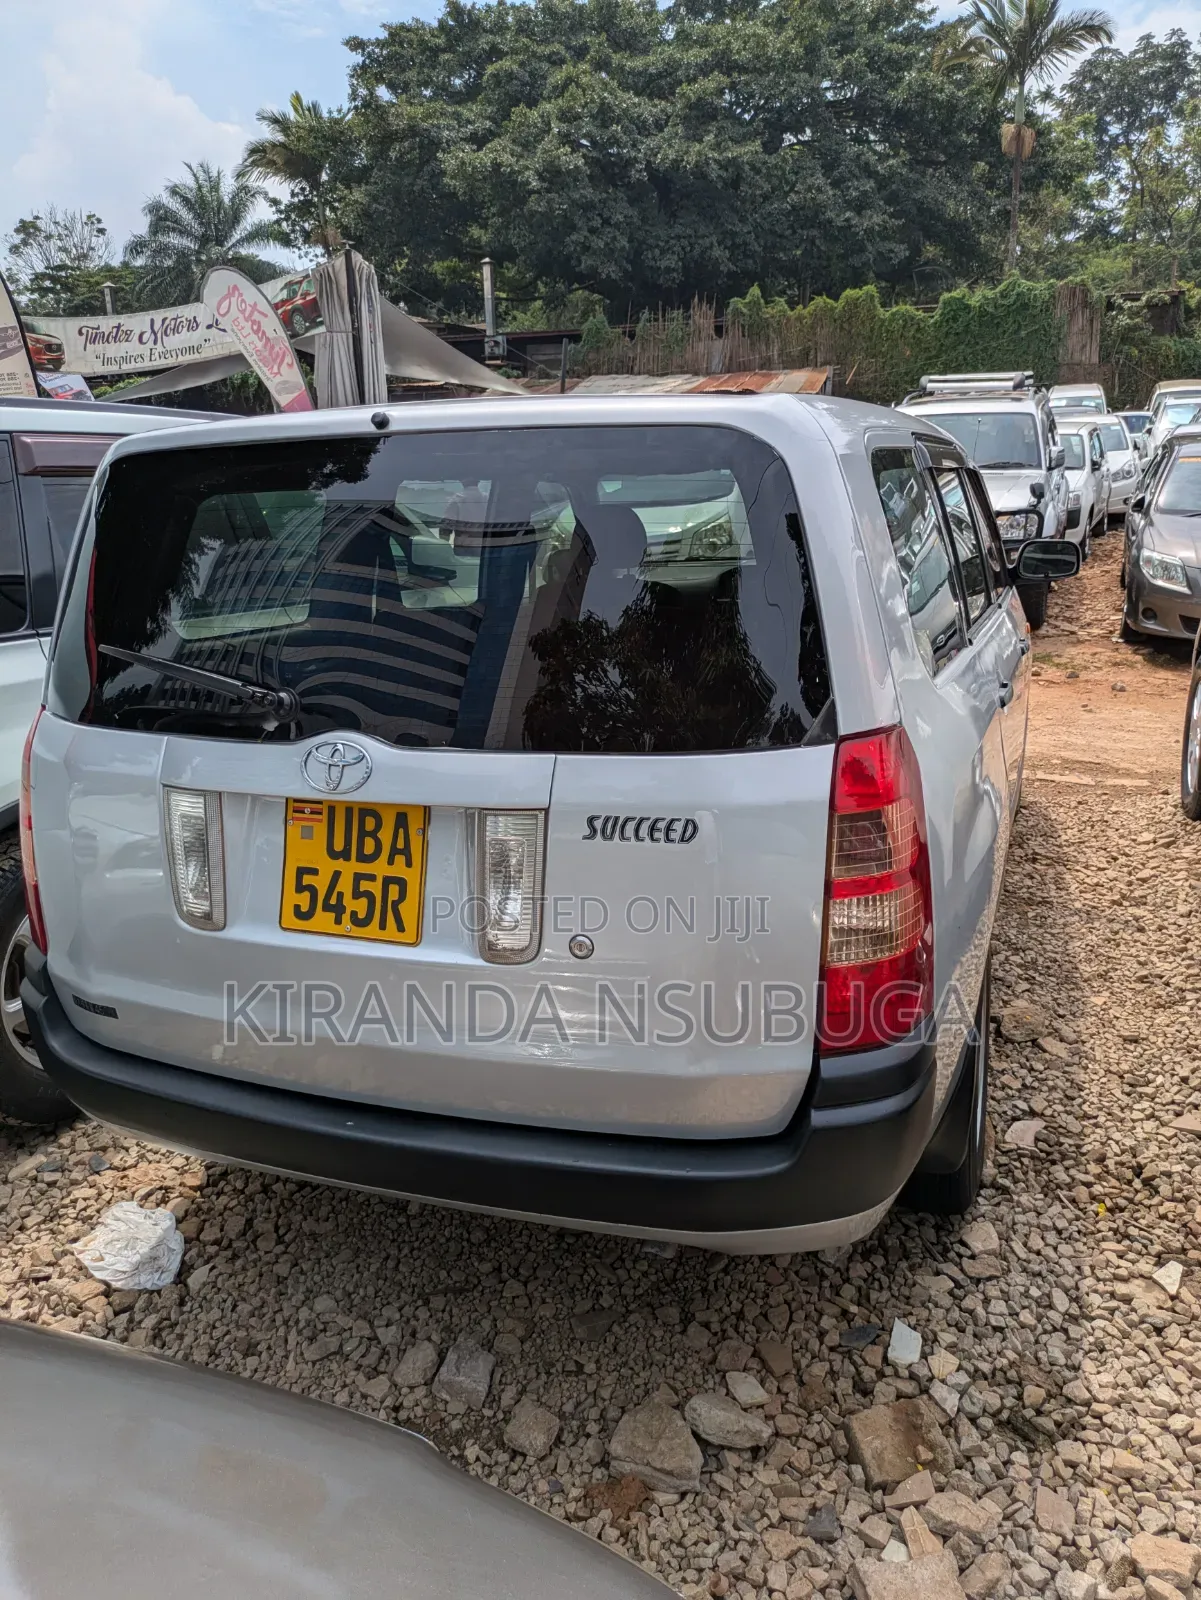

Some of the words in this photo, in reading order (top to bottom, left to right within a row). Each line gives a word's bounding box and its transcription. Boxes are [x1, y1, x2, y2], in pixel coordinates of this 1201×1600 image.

[78, 322, 135, 351] Timotez
[138, 313, 201, 348] Motors
[326, 805, 413, 869] UBA
[581, 813, 699, 845] SUCCEED
[293, 866, 408, 933] 545R
